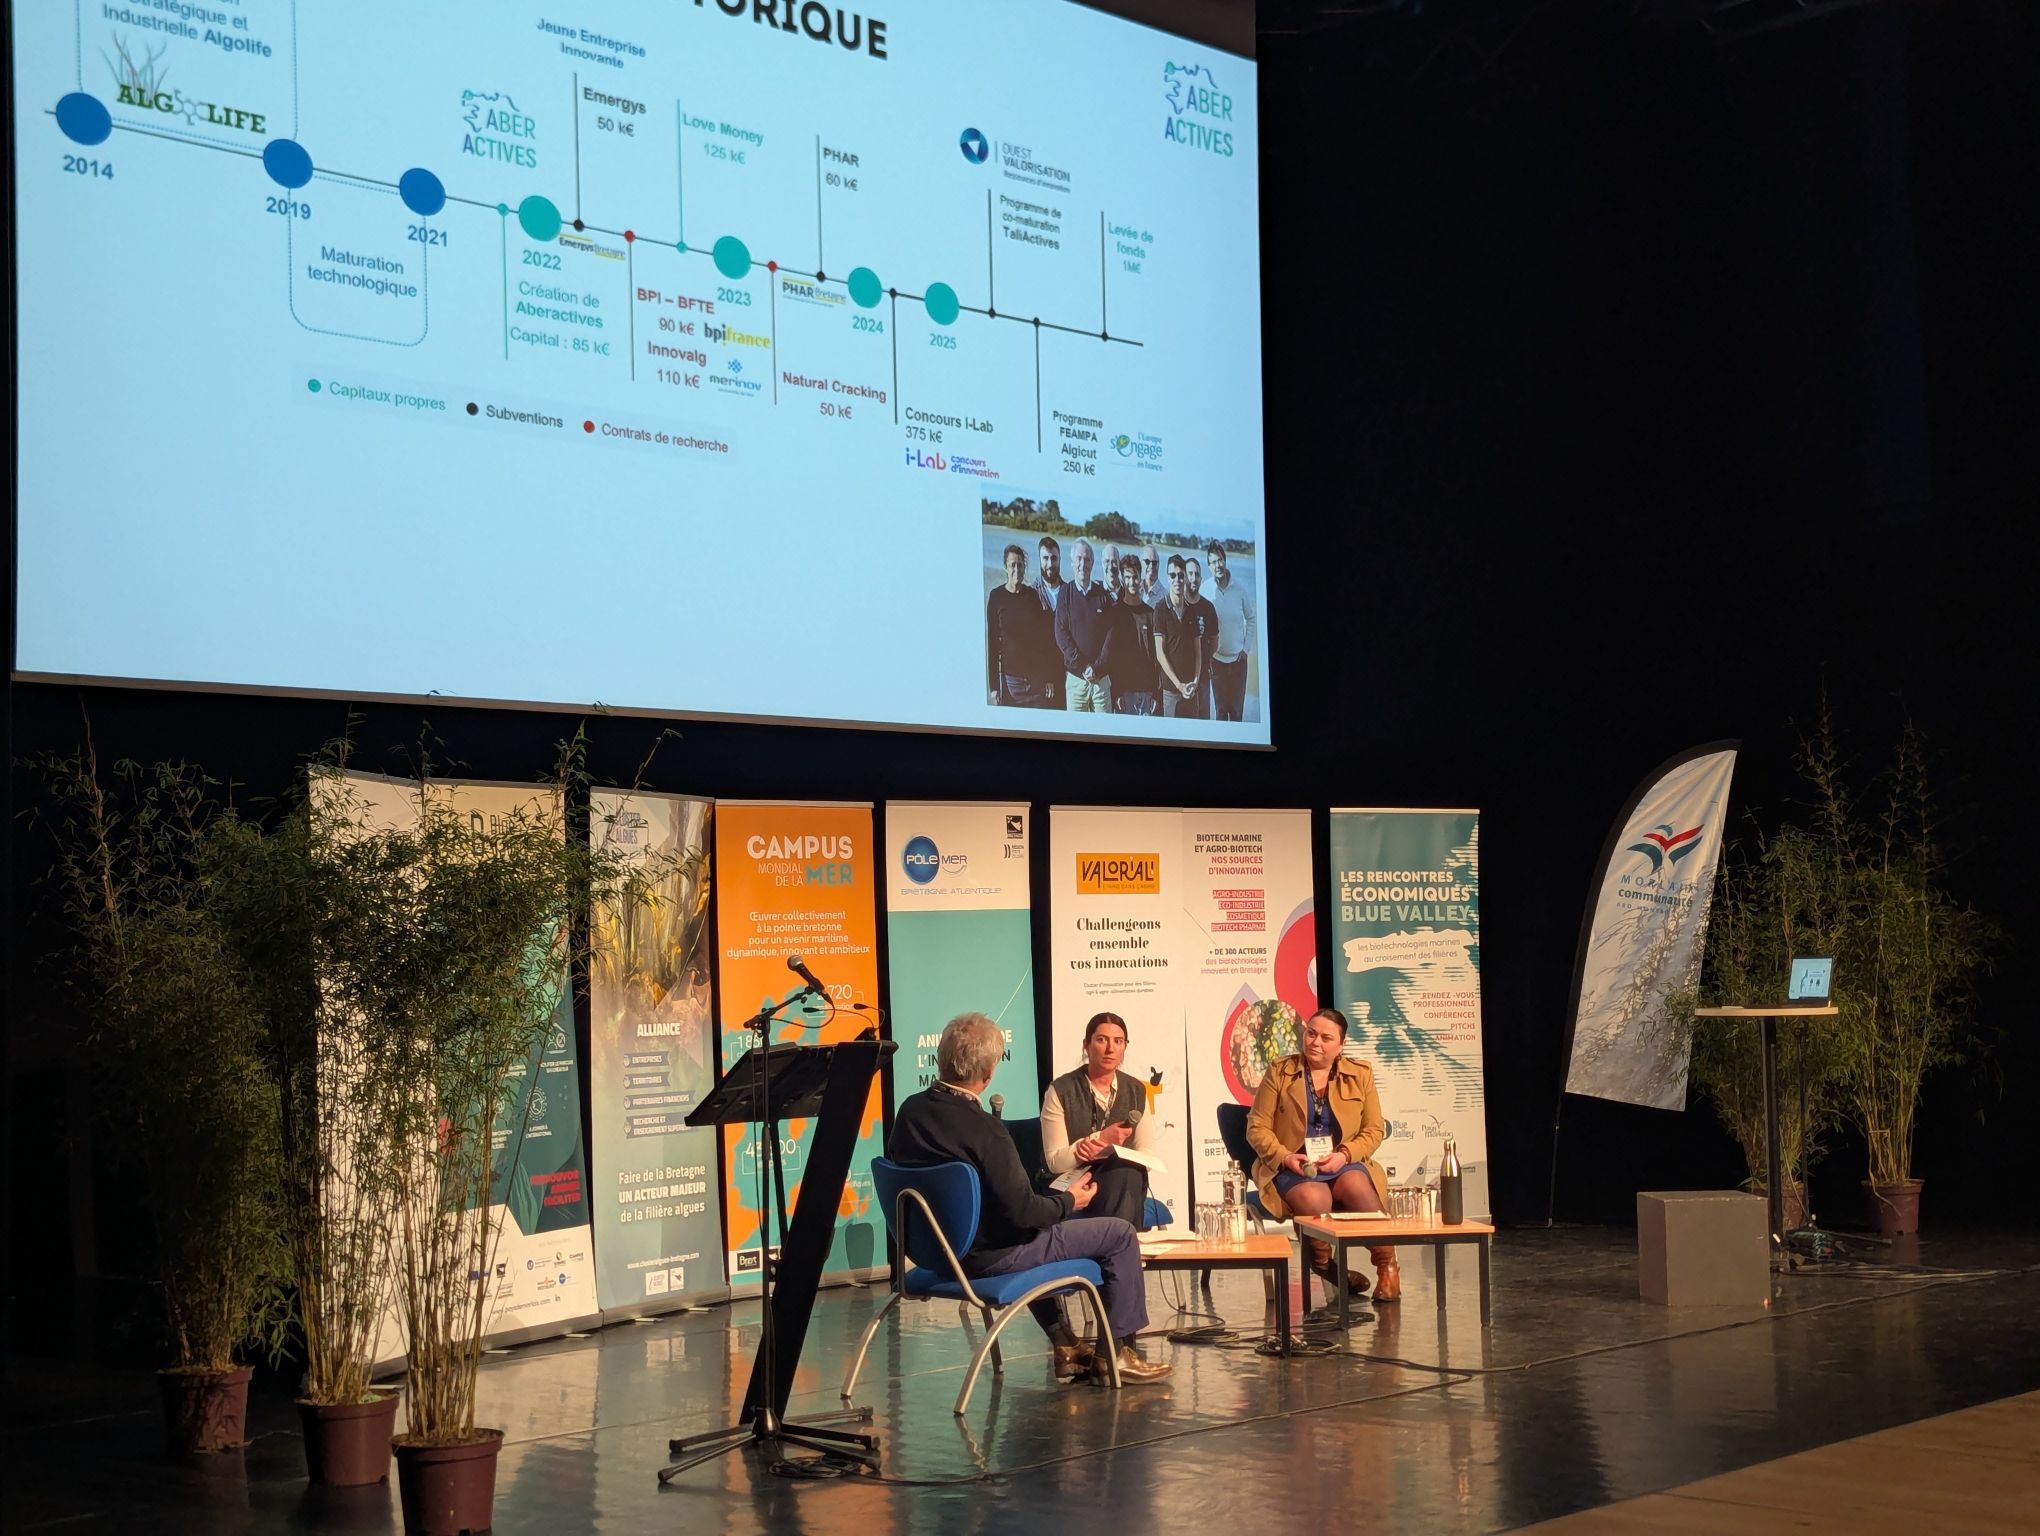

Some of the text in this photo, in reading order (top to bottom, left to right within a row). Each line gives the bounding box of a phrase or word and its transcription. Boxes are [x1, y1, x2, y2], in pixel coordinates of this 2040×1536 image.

[103, 3, 272, 58] Industrielle Algolife
[232, 16, 248, 31] et
[537, 18, 646, 59] Jeune Entreprise
[560, 42, 624, 69] Innovante
[583, 87, 647, 116] Emergys
[1186, 85, 1232, 122] ABER
[486, 109, 536, 140] ABER
[597, 116, 634, 138] 50 k€
[683, 112, 764, 148] Love Money
[1165, 116, 1233, 157] ACTIVES
[462, 134, 537, 169] ACTIVES
[704, 143, 746, 165] 125 k€
[823, 147, 860, 168] PHAR
[1002, 143, 1032, 160] OUEST
[63, 154, 114, 180] 2014
[1003, 156, 1070, 182] VALORISATION
[844, 176, 858, 192] k€
[266, 196, 311, 220] 2019
[1000, 195, 1062, 219] Programme de
[1002, 212, 1060, 234] co-maturation
[1108, 221, 1154, 244] Levée de
[408, 225, 448, 247] 2021
[1003, 226, 1060, 250] TaliActives
[321, 246, 404, 275] Maturation
[522, 249, 562, 271] 2022
[1116, 241, 1146, 260] fonds
[308, 265, 418, 298] technologique
[783, 281, 814, 299] PHAR
[519, 280, 600, 309] Création de
[637, 287, 715, 315] BPI BFTE
[717, 287, 752, 307] 2023
[516, 300, 604, 329] Aberactives
[659, 317, 695, 336] 90 k€
[704, 322, 770, 348] bpifrance
[852, 316, 884, 334] 2024
[510, 326, 611, 357] Capital 85 k€
[930, 333, 957, 350] 2025
[648, 341, 707, 367] Innovalg
[657, 369, 700, 389] 110 k€
[709, 375, 762, 391] merinov
[783, 371, 887, 404] Natural Cracking
[329, 382, 446, 412] Capitaux propres
[486, 404, 563, 428] Subventions
[820, 402, 853, 420] 50 k€
[905, 406, 961, 429] Concours
[1053, 410, 1103, 429] Programme
[602, 423, 729, 455] Contrats de recherche
[905, 425, 943, 445] 375 k€
[1059, 426, 1098, 443] FEAMPA
[905, 447, 947, 472] i-Lab
[1061, 442, 1097, 460] Algicut
[951, 455, 987, 469] concours
[1063, 460, 1096, 478] 250 k€
[747, 835, 853, 860] CAMPUS
[1197, 834, 1262, 842] BIOTECH MARINE
[1195, 845, 1263, 853] ET AGRO-BIOTECH
[758, 863, 804, 875] MONDIAL
[1211, 856, 1263, 864] NOS SOURCES
[775, 864, 853, 886] DE LA MER
[1208, 867, 1264, 875] D'INNOVATION
[1341, 871, 1454, 883] LES RENCONTRES
[1341, 883, 1471, 902] ÉCONOMIQUES
[1618, 889, 1693, 907] communauté
[749, 910, 846, 921] Œuvrer collectivement
[1341, 905, 1471, 922] BLUE VALLEY
[757, 921, 842, 934] à la pointe bretonne
[1076, 918, 1161, 932] Challengeons
[749, 933, 849, 947] pour un avenir maritime
[1089, 936, 1149, 950] ensemble
[1358, 938, 1461, 951] les biotechnologies marines
[727, 944, 870, 960] dynamique, innovant et ambitieux
[1219, 957, 1267, 966] biotechnologies
[1364, 950, 1458, 964] au croisement des filières
[1070, 955, 1168, 970] vos innovations
[1240, 967, 1267, 976] Bretagne
[1413, 1000, 1475, 1008] PROFESSIONNELS
[637, 1022, 681, 1037] ALLIANCE
[1435, 1033, 1476, 1041] ANIMATION
[1393, 1120, 1408, 1129] Blue
[1393, 1128, 1415, 1139] Valley
[619, 1165, 706, 1184] Faire de la Bretagne
[619, 1182, 706, 1203] UN ACTEUR MAJEUR
[620, 1202, 705, 1223] de la filière algues
